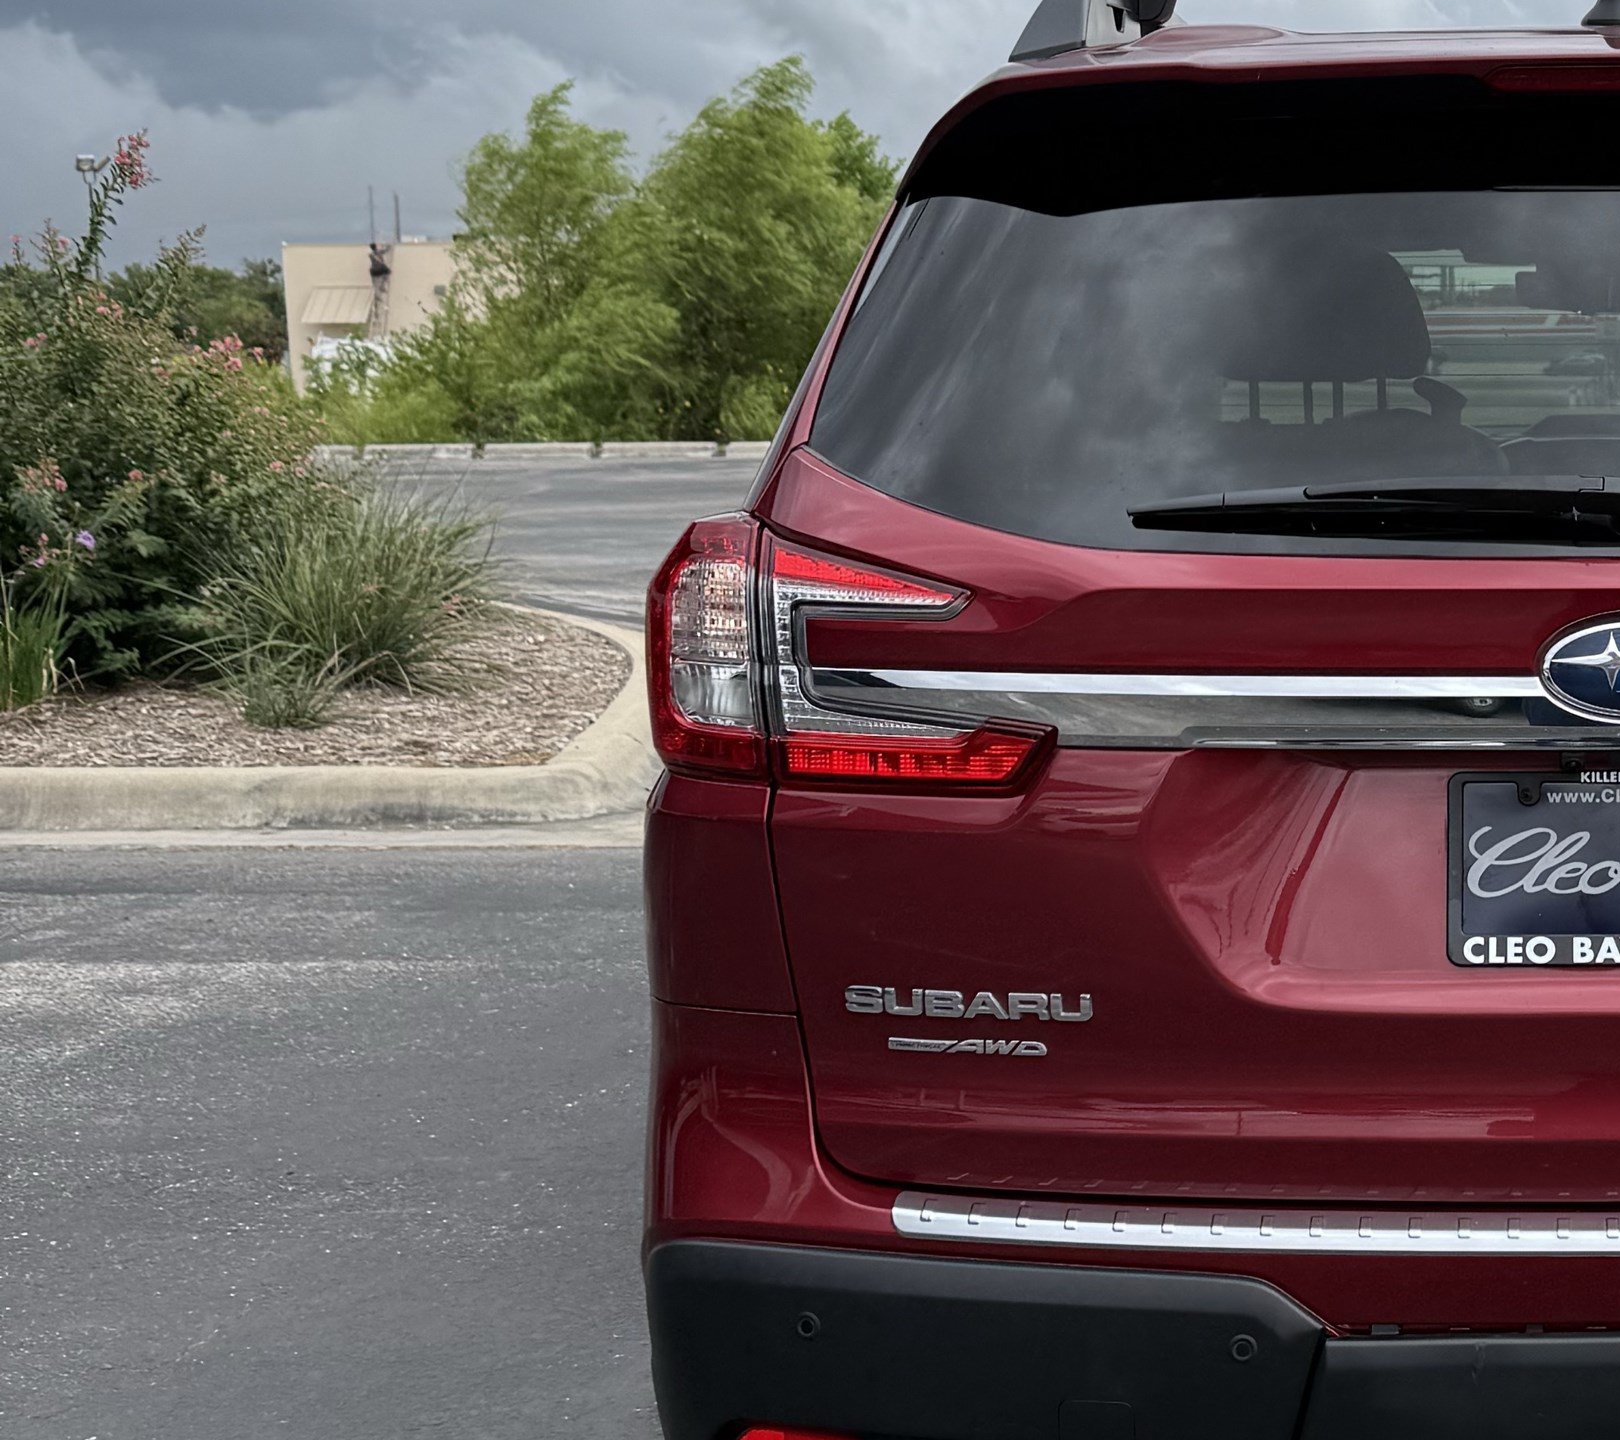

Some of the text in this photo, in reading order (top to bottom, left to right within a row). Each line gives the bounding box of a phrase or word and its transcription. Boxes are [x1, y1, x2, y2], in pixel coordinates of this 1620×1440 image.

[1463, 936, 1556, 964] CLEO
[845, 985, 1094, 1022] SUBARU
[946, 1038, 1048, 1056] AWD
